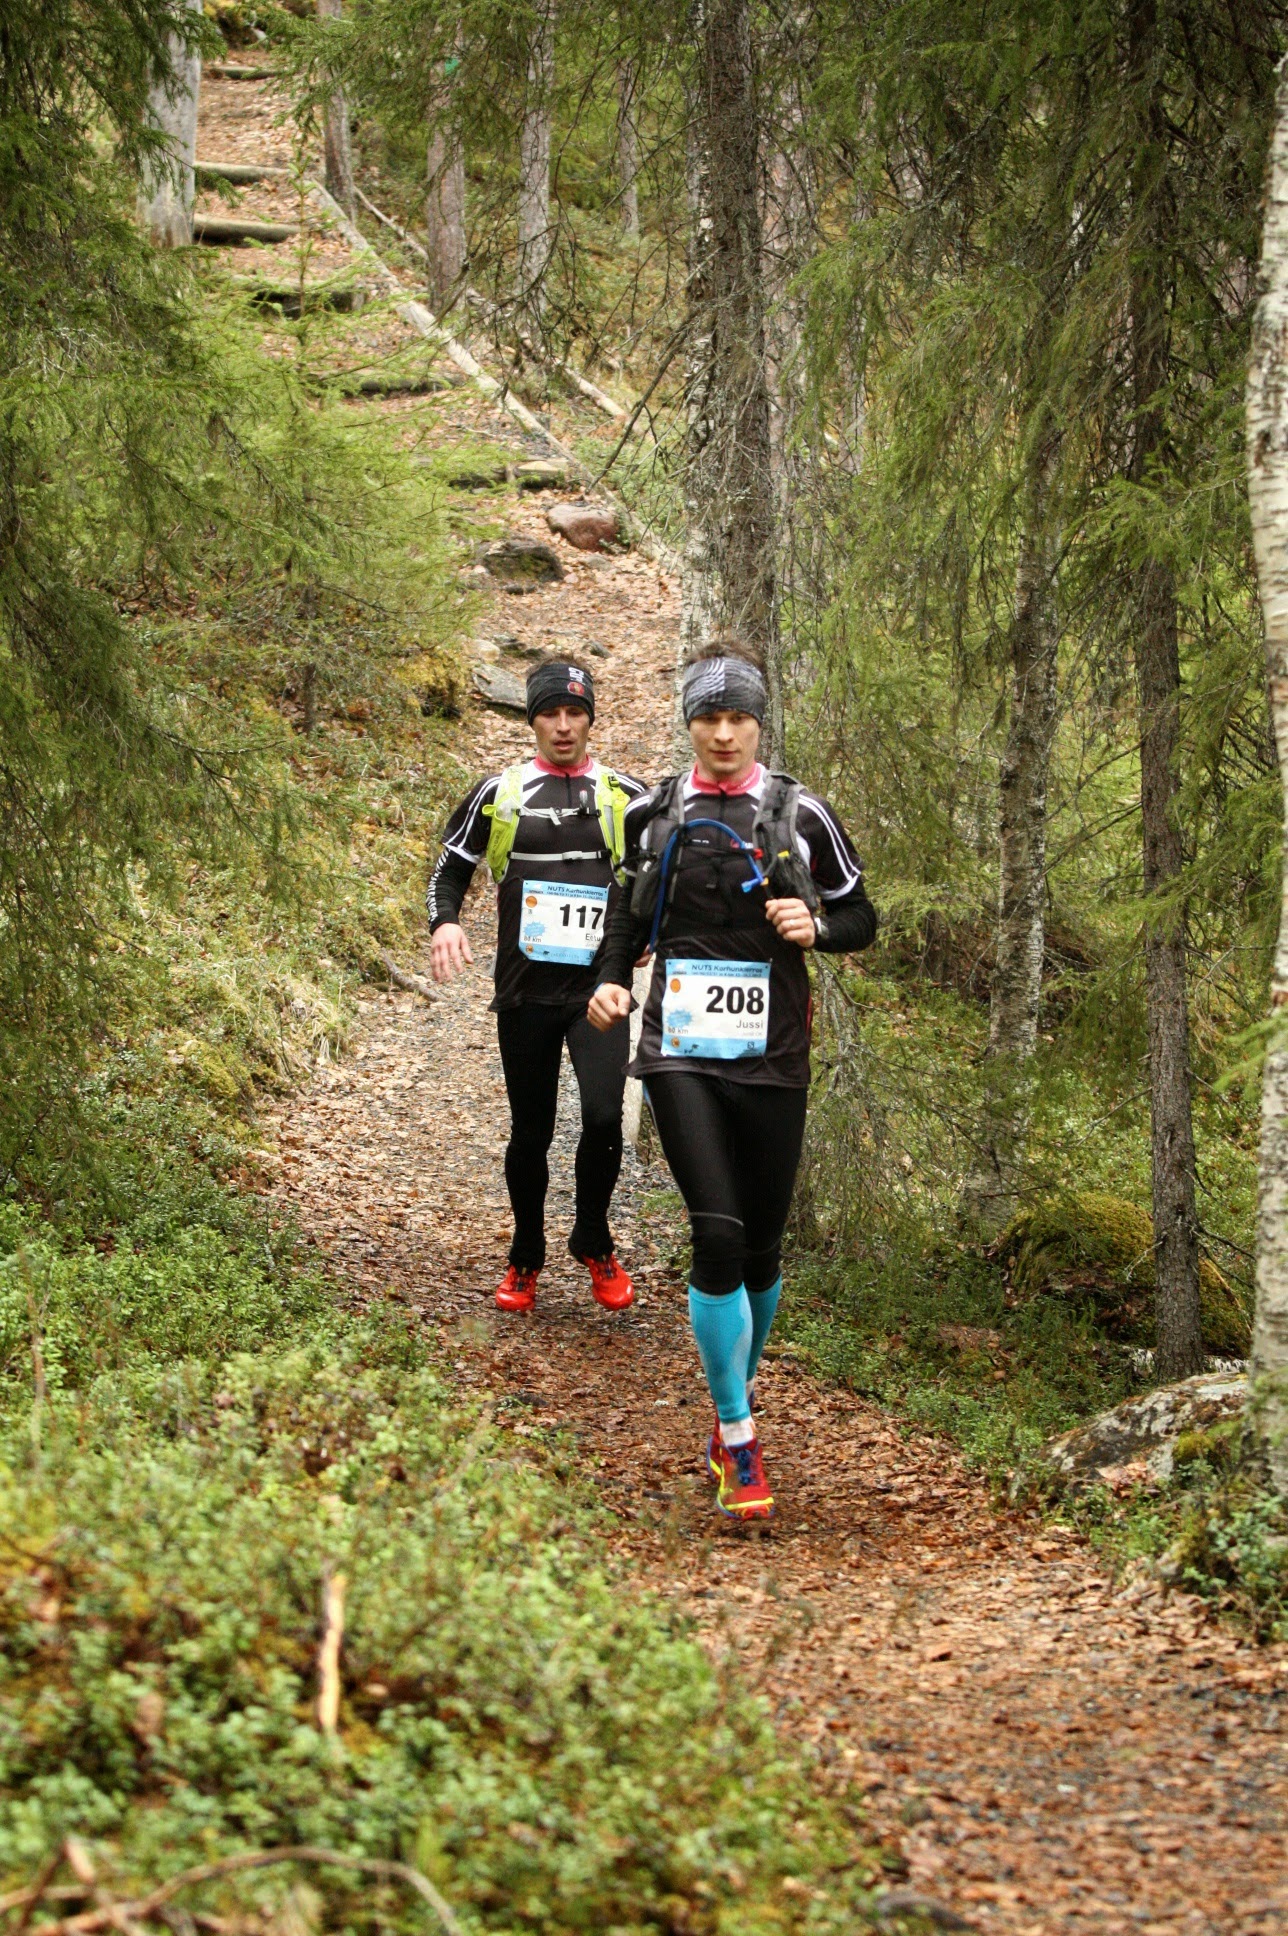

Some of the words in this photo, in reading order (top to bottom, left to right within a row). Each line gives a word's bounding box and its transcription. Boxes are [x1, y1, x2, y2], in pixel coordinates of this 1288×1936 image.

[560, 904, 603, 929] 117
[706, 985, 764, 1014] 208
[736, 1020, 764, 1029] Jussi
